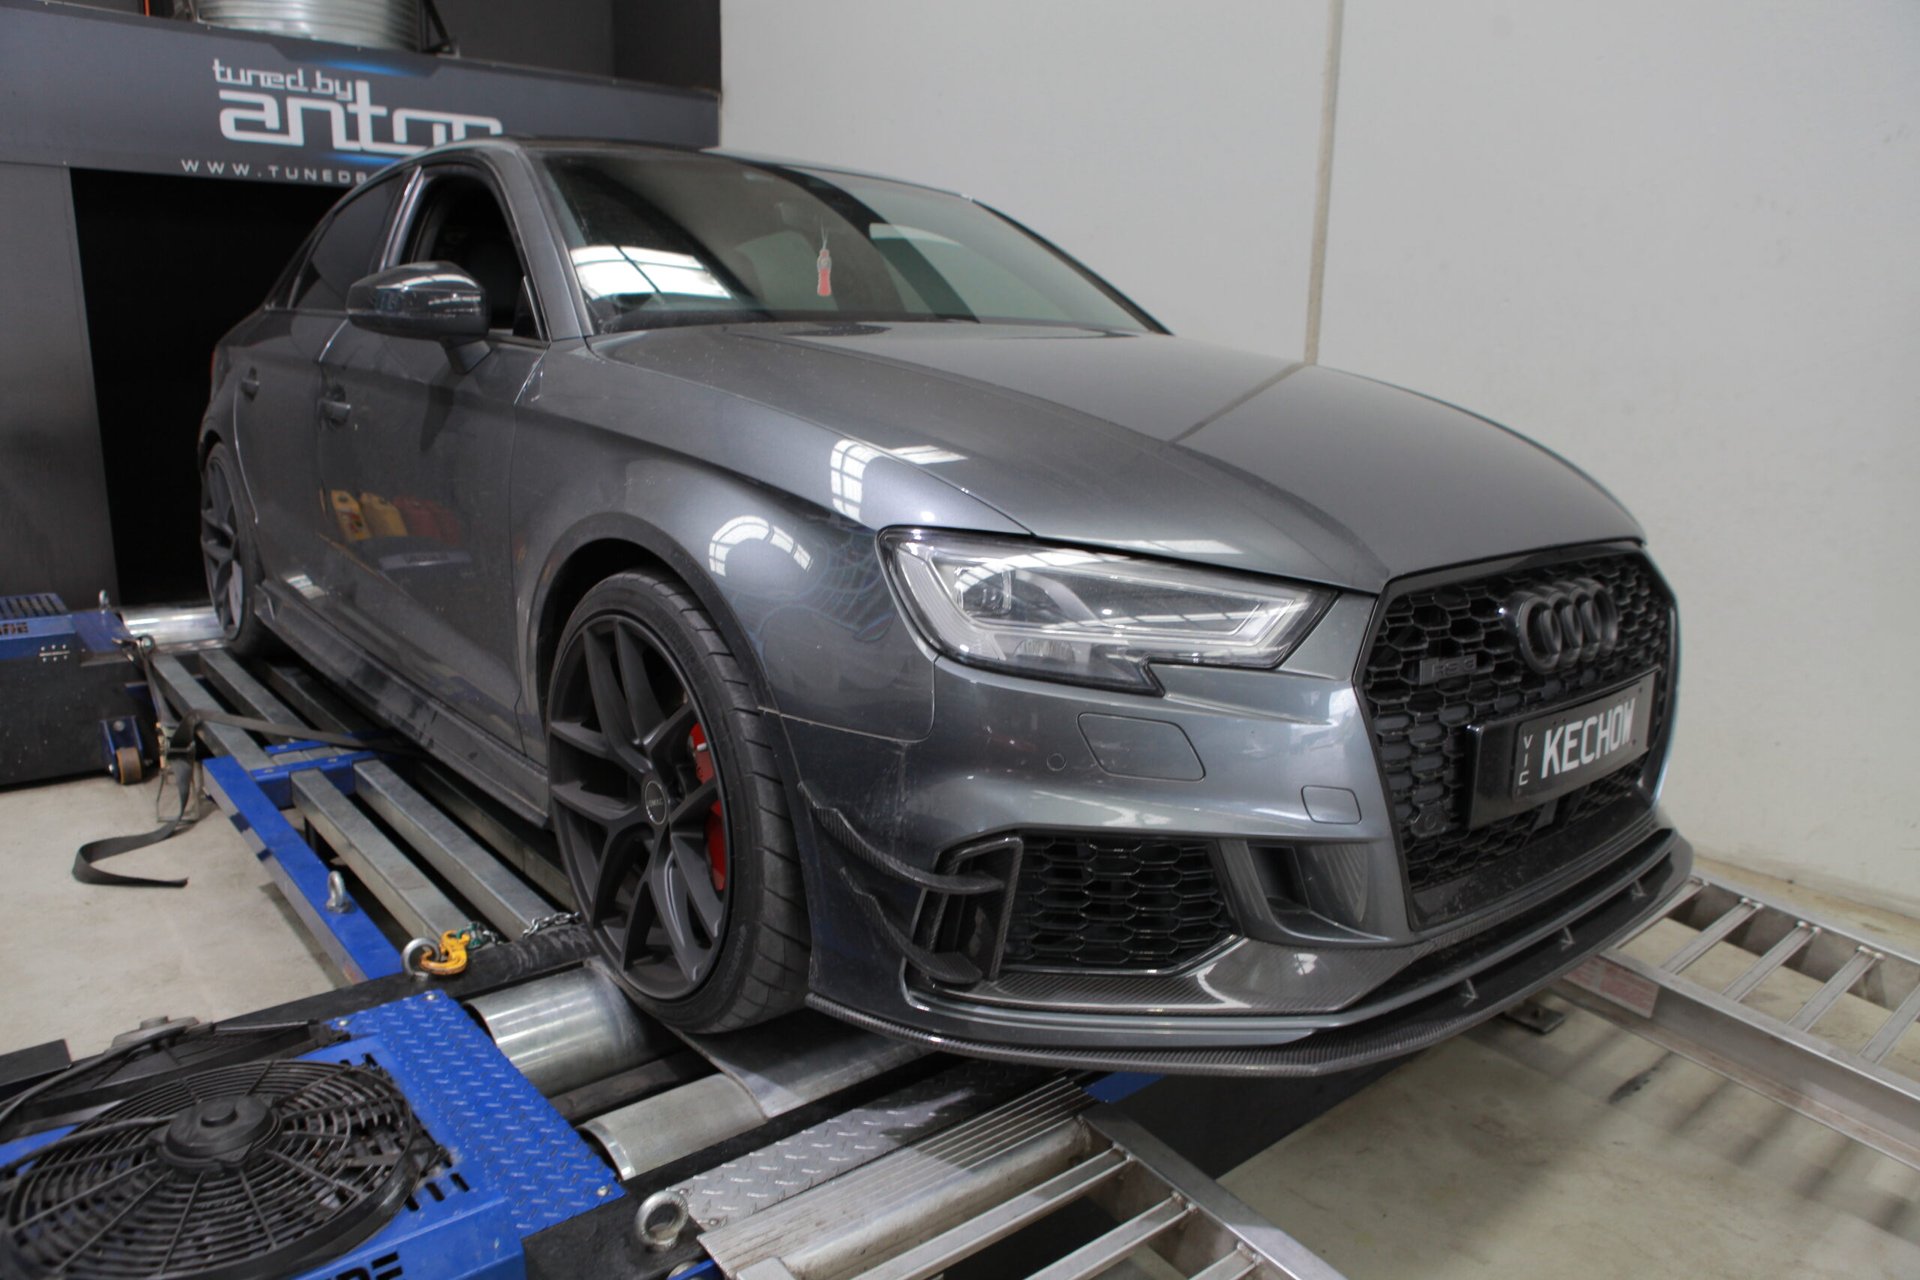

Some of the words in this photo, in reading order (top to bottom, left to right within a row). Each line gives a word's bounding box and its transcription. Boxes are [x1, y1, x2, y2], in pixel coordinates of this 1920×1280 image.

[212, 58, 307, 92] tuned
[311, 69, 354, 100] by
[181, 158, 368, 185] WWW.TUNEDB
[1540, 697, 1636, 780] KECHOW
